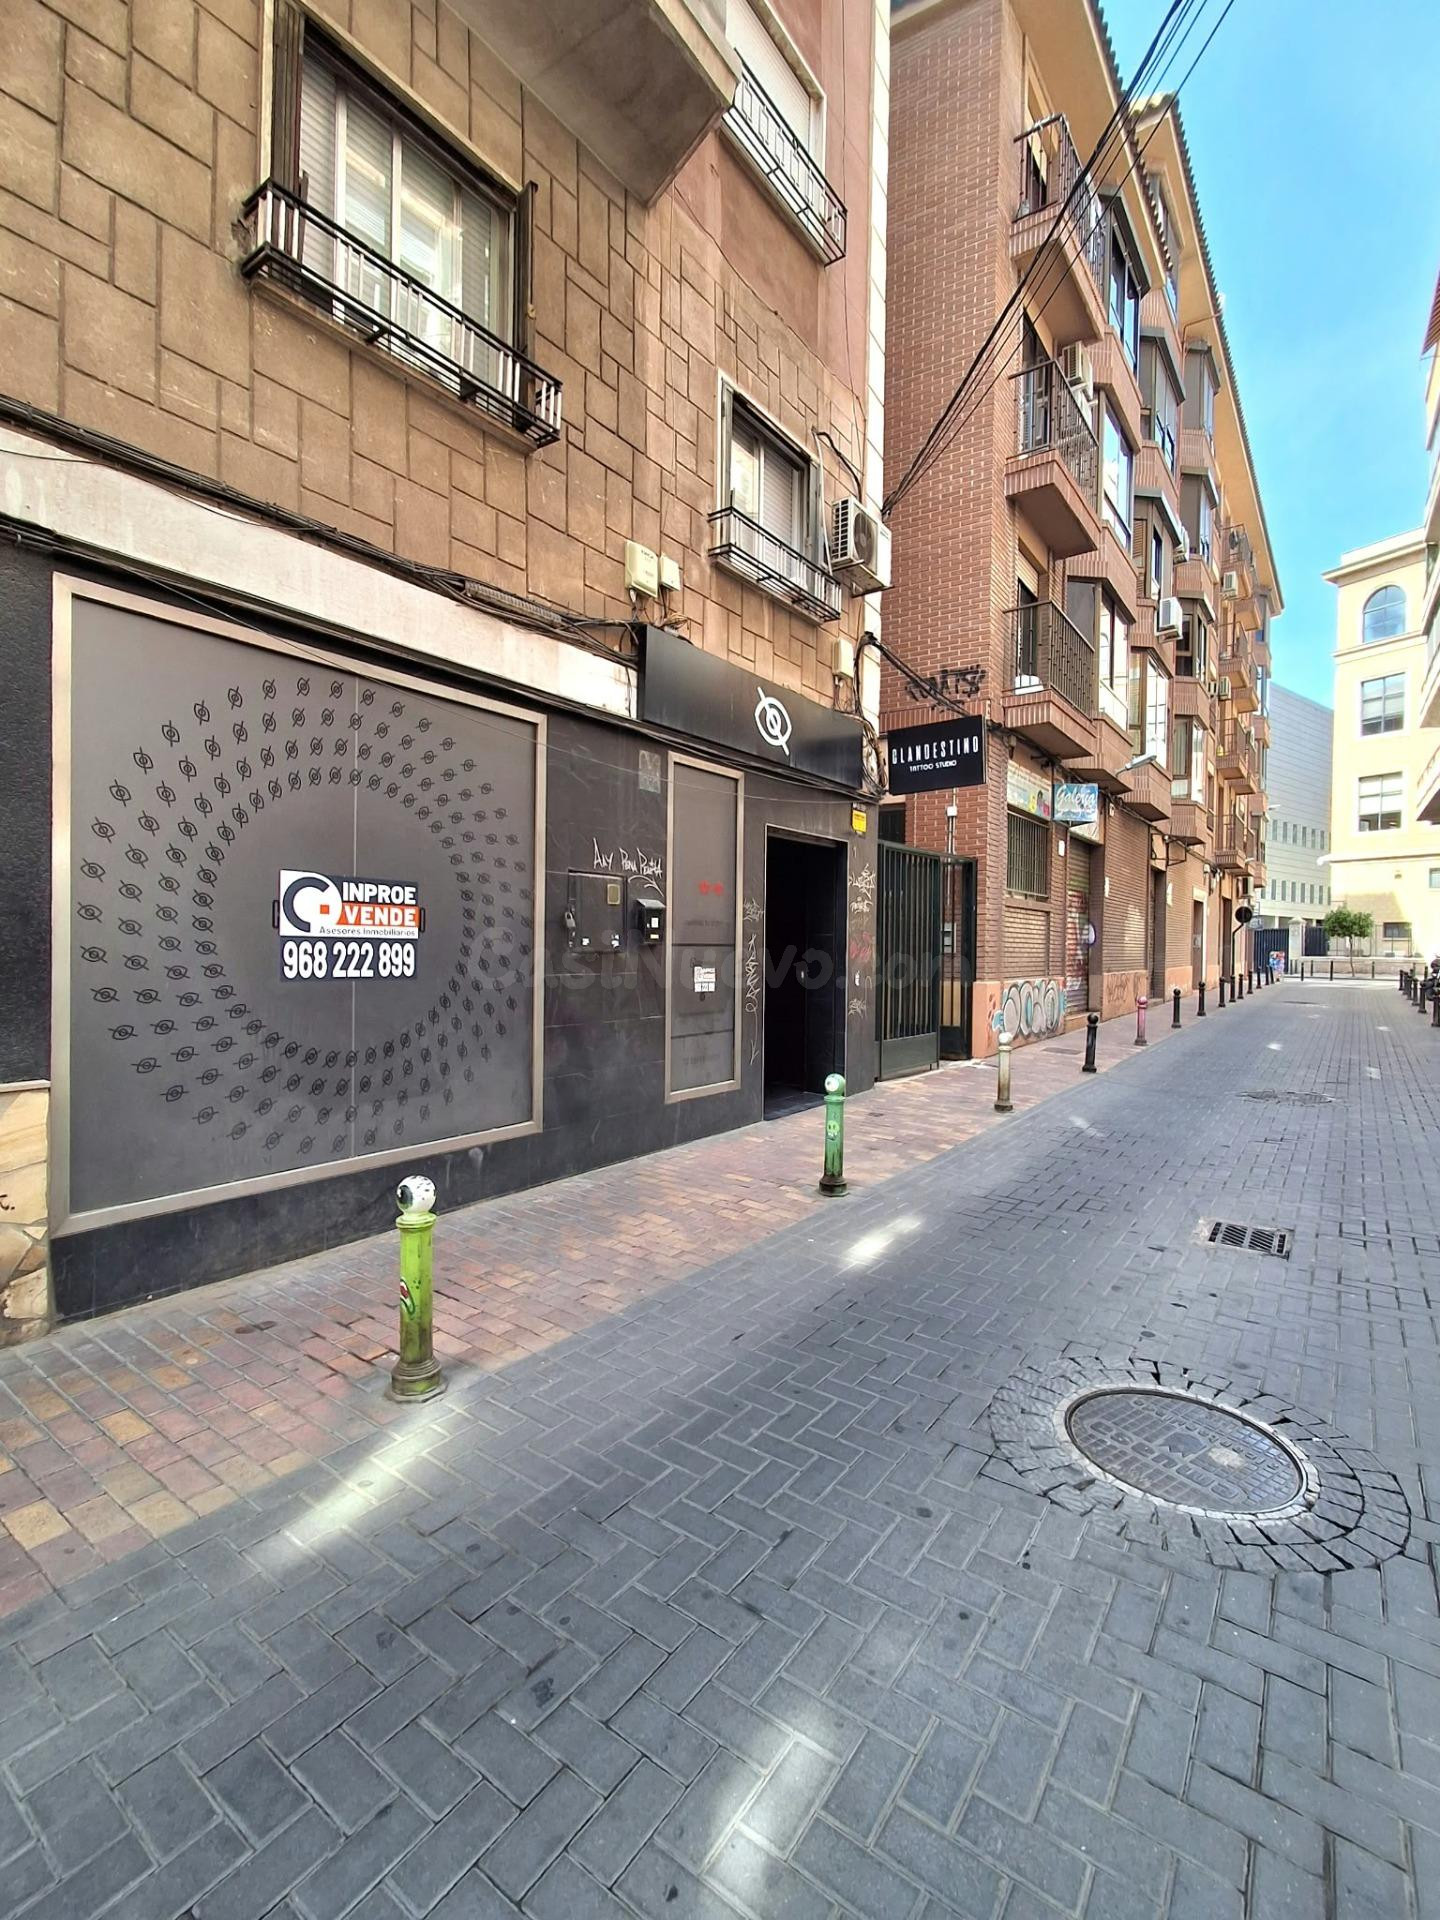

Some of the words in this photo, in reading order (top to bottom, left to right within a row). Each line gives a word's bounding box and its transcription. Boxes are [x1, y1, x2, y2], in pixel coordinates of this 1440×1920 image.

[892, 736, 979, 765] CLANDESTINO
[909, 763, 934, 773] TATTOO
[935, 759, 957, 769] STUDIO
[343, 881, 416, 905] INPROE
[344, 905, 416, 926] VENDE
[319, 926, 361, 936] Asesores
[283, 940, 328, 979] 968
[332, 941, 374, 979] 222
[378, 941, 416, 978] 899
